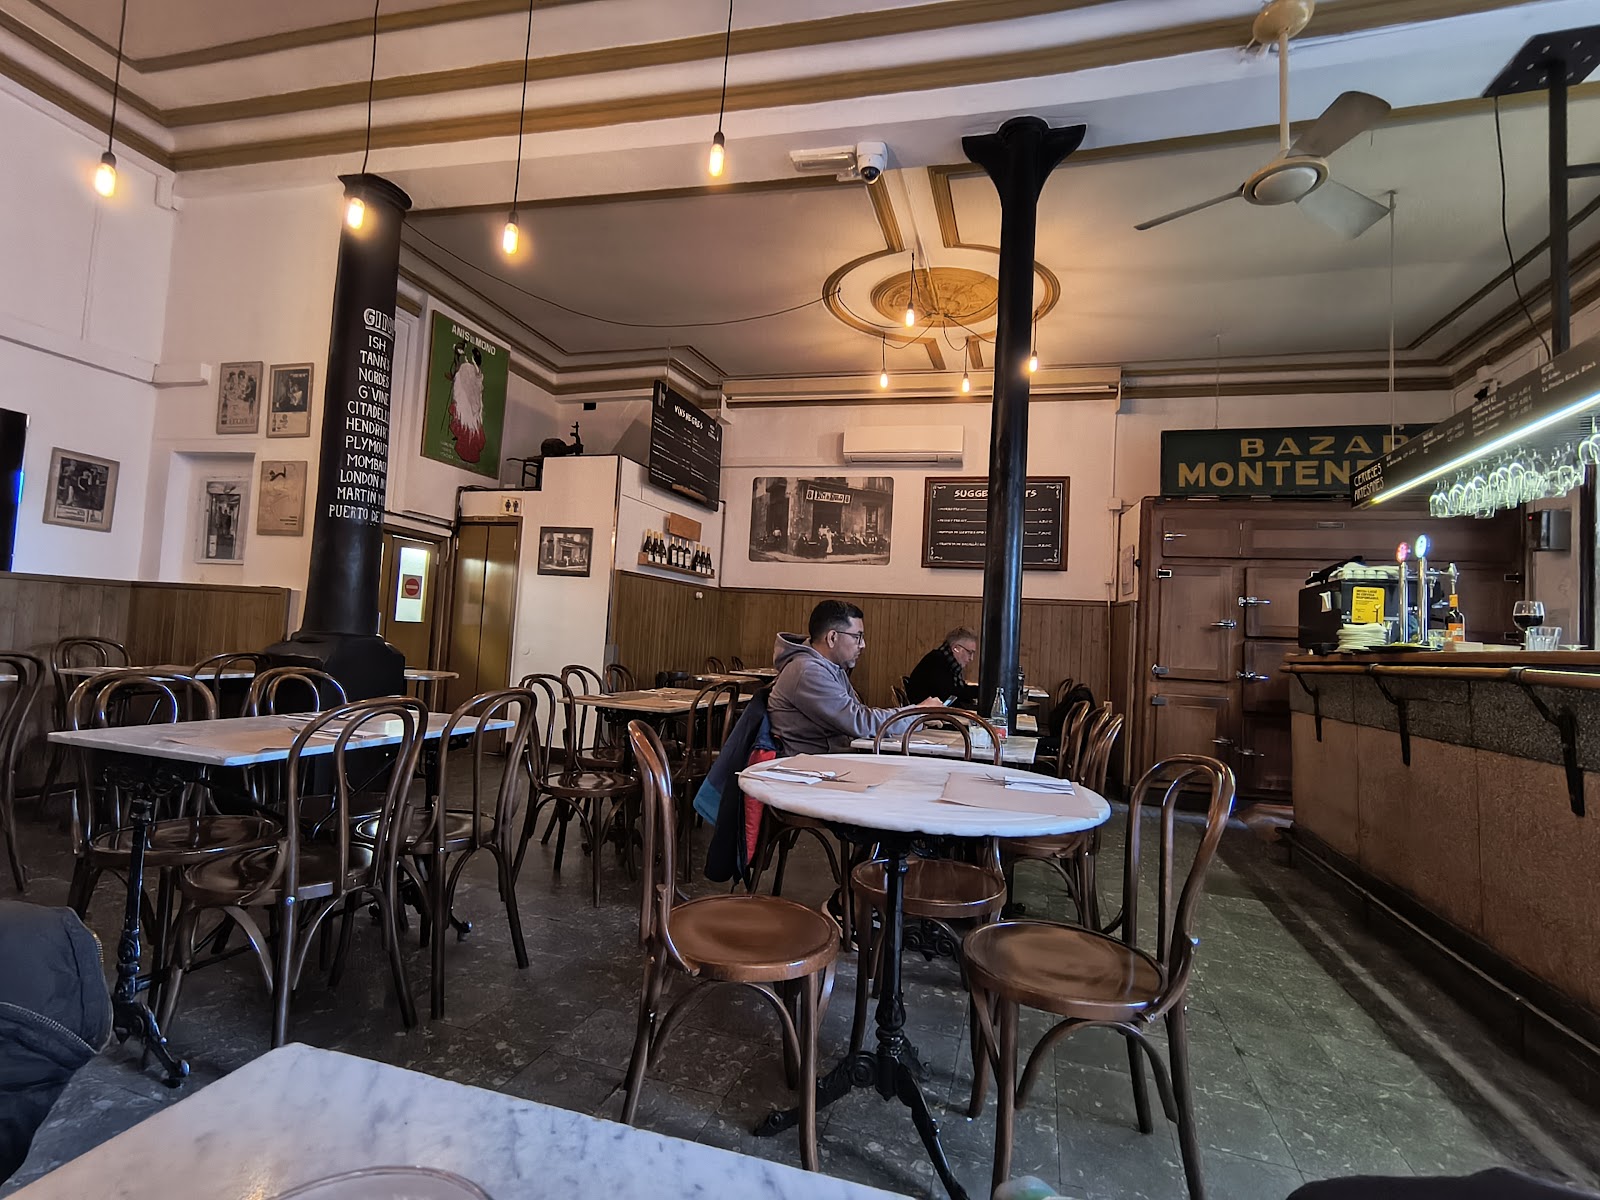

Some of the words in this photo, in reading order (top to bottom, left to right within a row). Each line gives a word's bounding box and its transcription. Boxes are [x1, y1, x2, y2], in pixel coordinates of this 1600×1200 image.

[368, 335, 387, 352] ISH
[451, 324, 470, 342] ANIS
[475, 336, 496, 356] MONO
[358, 367, 390, 388] NORDES
[339, 469, 380, 488] LONDON
[328, 504, 369, 520] PUERTO
[370, 510, 381, 523] DE
